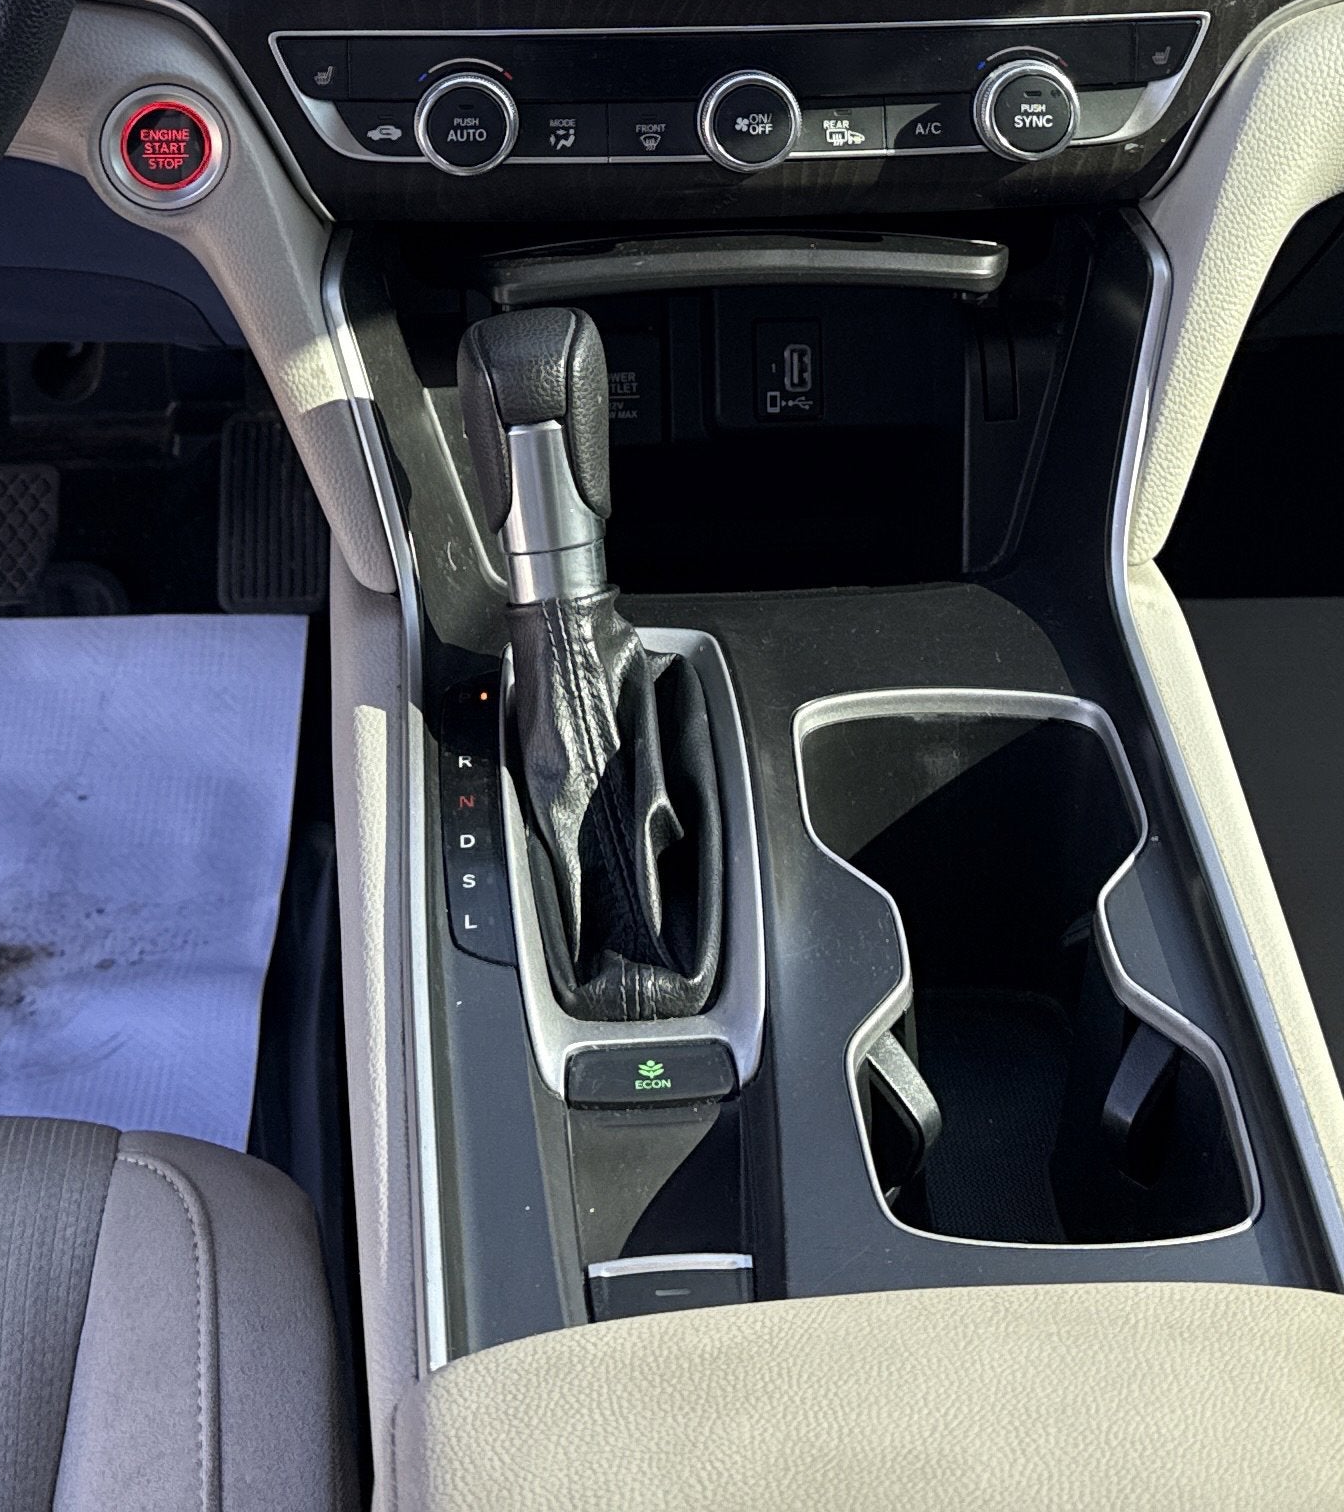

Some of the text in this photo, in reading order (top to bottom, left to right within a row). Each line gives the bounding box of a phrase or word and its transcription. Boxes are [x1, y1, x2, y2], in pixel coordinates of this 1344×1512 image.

[1021, 104, 1046, 113] PUSH
[453, 117, 479, 127] PUSH
[549, 119, 576, 128] MODE
[749, 114, 772, 124] ON/
[823, 120, 850, 129] REAR
[1014, 114, 1054, 129] SYNC
[635, 123, 667, 133] FRONT
[749, 124, 774, 134] OFF
[915, 122, 942, 135] A/C
[140, 129, 190, 141] ENGINE
[447, 129, 487, 143] AUTO
[144, 142, 187, 154] START
[148, 158, 184, 169] STOP
[609, 372, 636, 383] WER
[618, 410, 638, 419] MAX
[458, 755, 473, 768] R
[459, 795, 475, 807] N
[460, 834, 475, 848] D
[462, 874, 476, 888] S
[464, 914, 477, 929] L
[635, 1079, 672, 1090] ECON
